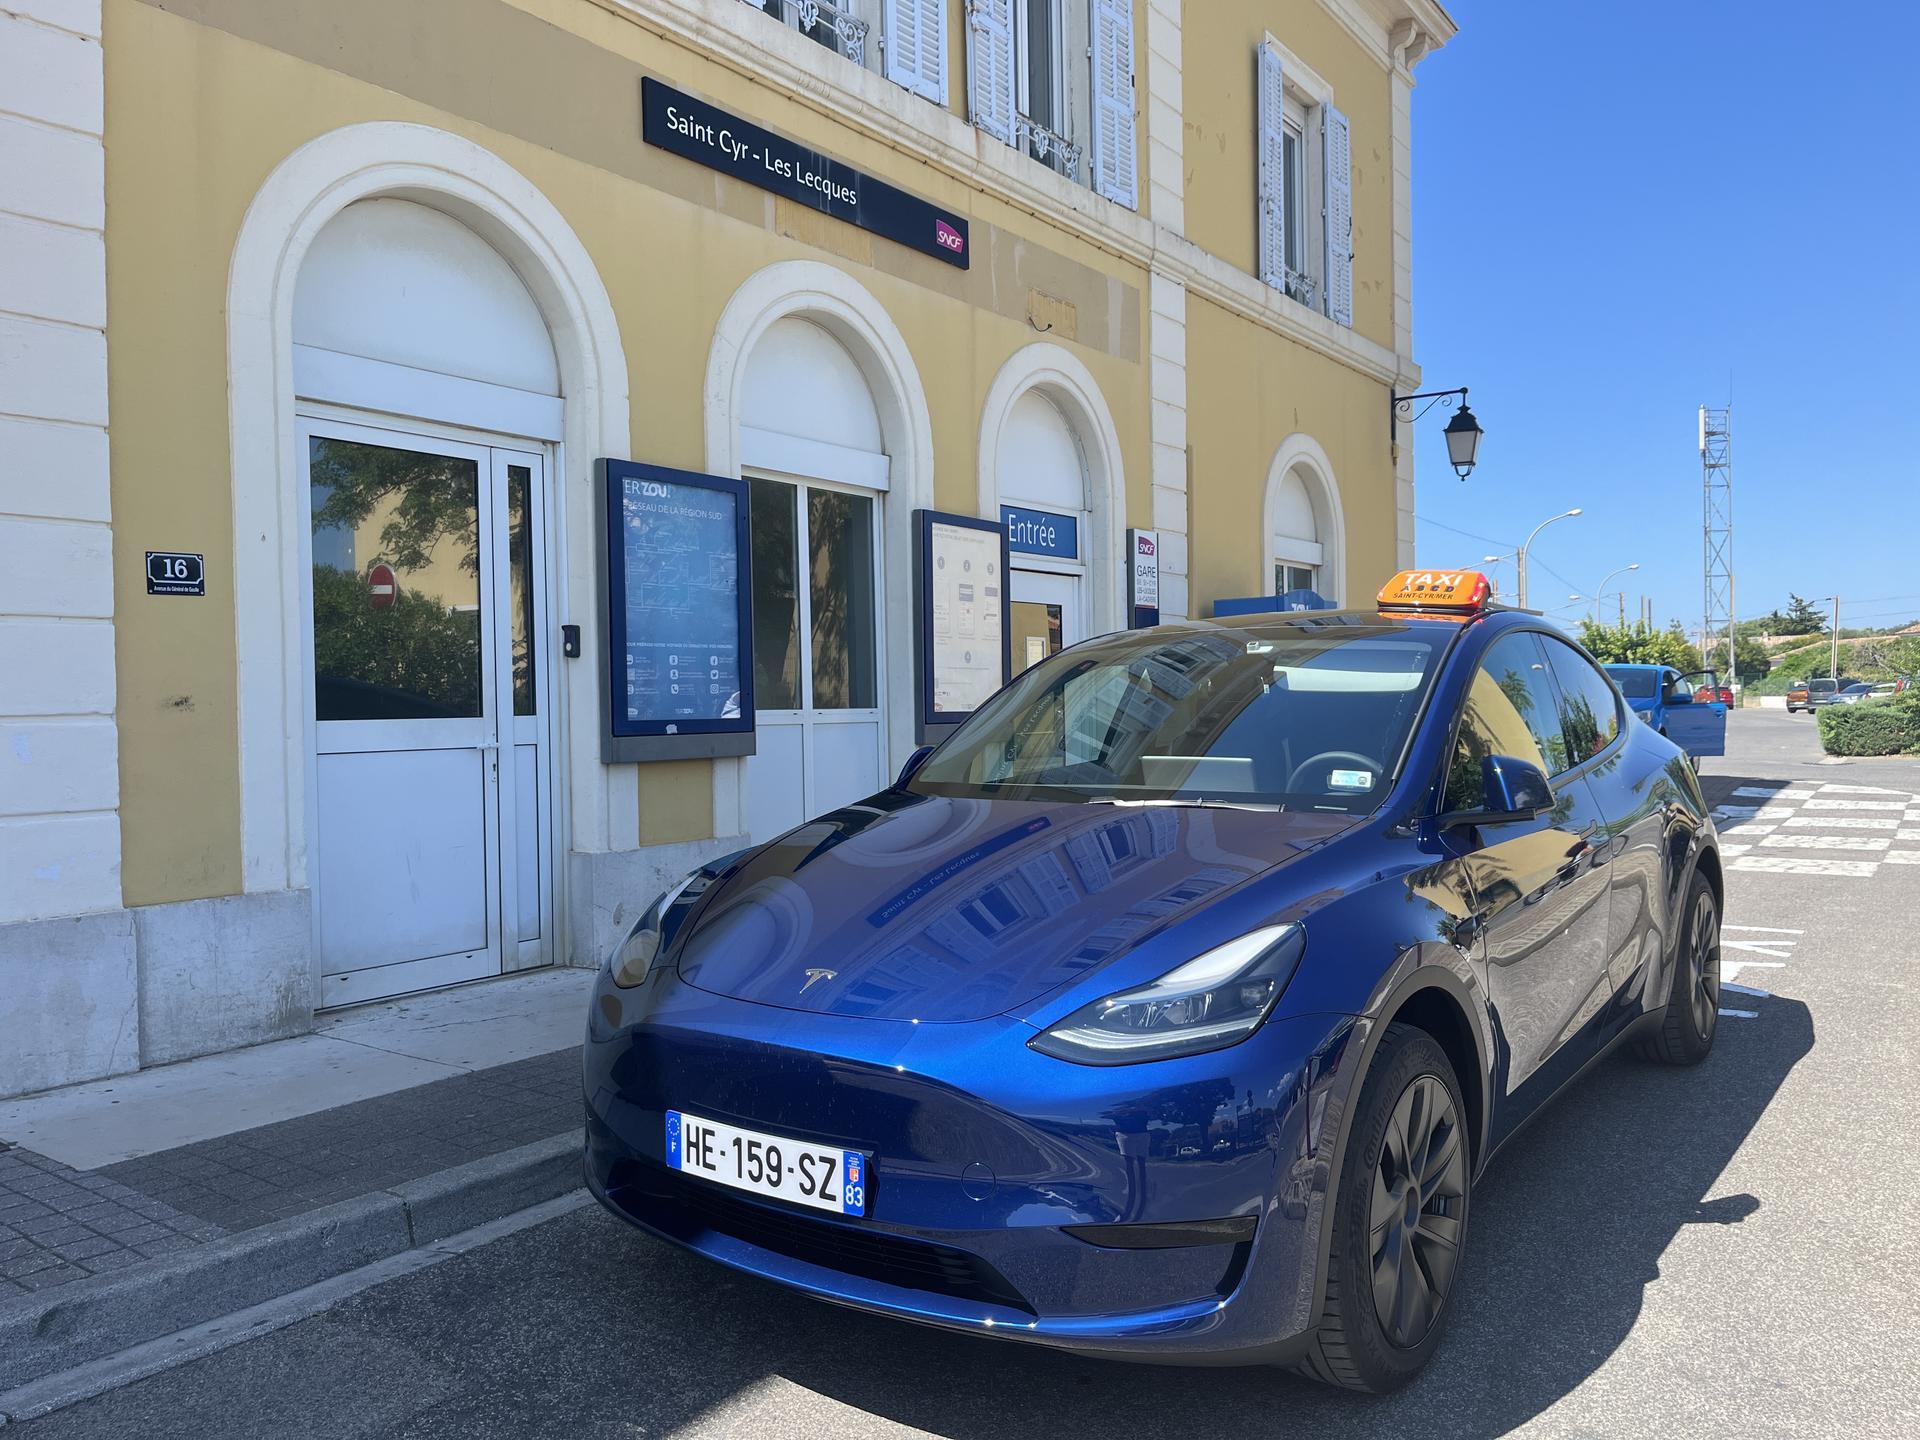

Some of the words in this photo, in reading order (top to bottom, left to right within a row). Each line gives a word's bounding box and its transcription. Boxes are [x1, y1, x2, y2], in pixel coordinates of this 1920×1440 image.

[666, 106, 715, 146] Saint
[719, 130, 749, 161] Cyr
[765, 148, 792, 178] Les
[796, 162, 857, 205] Lecques
[937, 230, 963, 249] SNCF
[623, 480, 641, 495] ER
[658, 505, 670, 514] DE
[670, 506, 680, 515] LA
[680, 507, 707, 518] RÉGION
[708, 511, 722, 520] SUD
[1008, 514, 1056, 547] Entrée
[1139, 543, 1155, 554] SNCF
[163, 558, 188, 578] 16
[1137, 565, 1156, 578] GARE
[1404, 573, 1464, 586] TAXI
[671, 1141, 677, 1153] F
[685, 1123, 837, 1202] HE-159-SZ
[845, 1185, 863, 1207] 83
